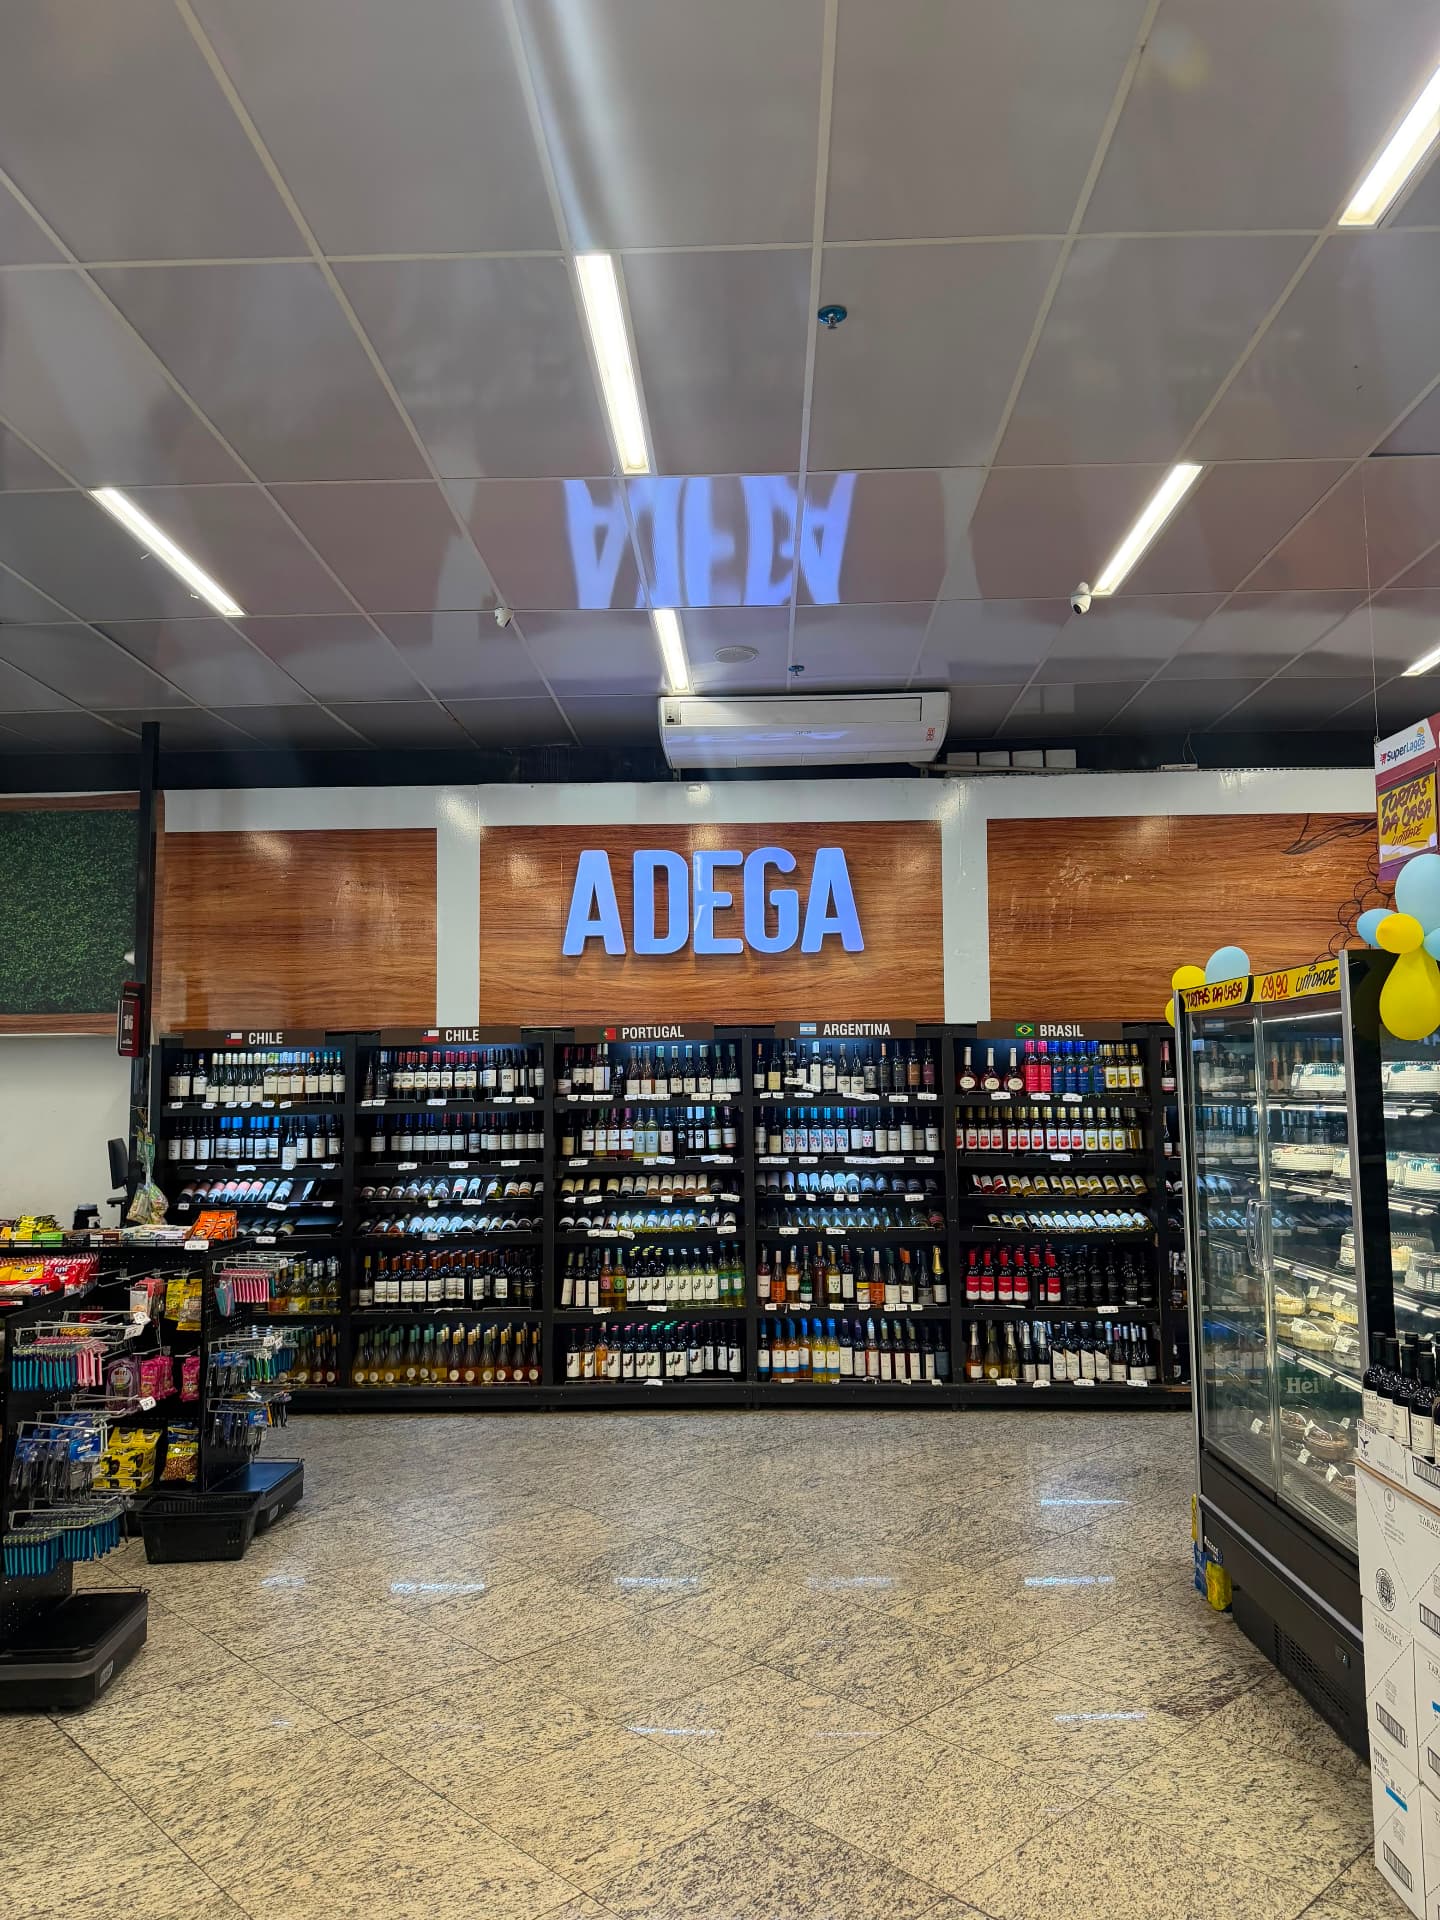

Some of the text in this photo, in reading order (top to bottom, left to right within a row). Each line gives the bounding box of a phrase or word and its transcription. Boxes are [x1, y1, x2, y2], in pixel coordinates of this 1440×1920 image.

[1381, 776, 1430, 818] TORTAS
[1381, 798, 1431, 835] DA CASA
[562, 847, 865, 956] ADEGA
[1212, 986, 1223, 1001] DA
[1224, 981, 1242, 1000] CASA
[1261, 974, 1288, 1000] 69,90
[445, 1029, 480, 1042] CHILE
[621, 1025, 684, 1040] PORTUGAL
[823, 1023, 891, 1036] ARGENTINA
[1039, 1024, 1084, 1037] BRASIL
[248, 1032, 283, 1045] CHILE
